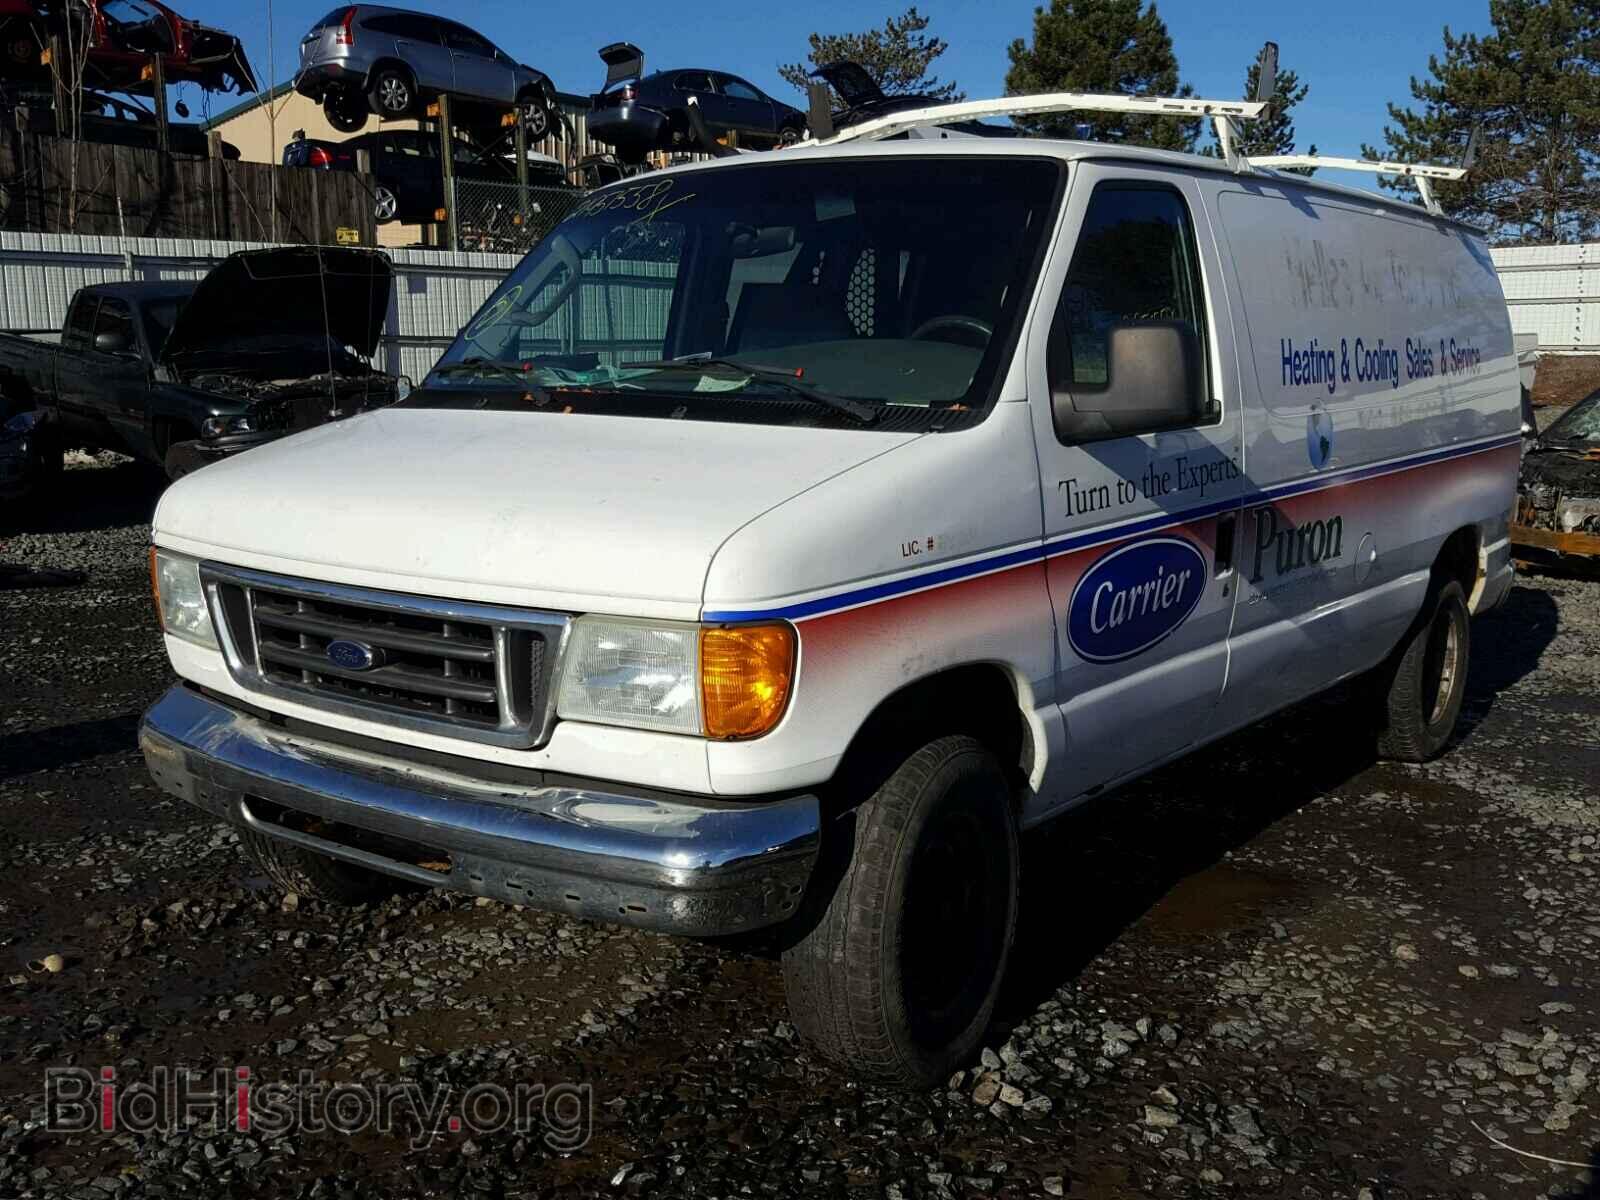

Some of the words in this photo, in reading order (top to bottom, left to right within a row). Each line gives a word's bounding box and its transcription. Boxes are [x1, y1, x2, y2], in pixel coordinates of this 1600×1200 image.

[1281, 337, 1336, 394] Heating
[1340, 338, 1351, 383] &
[1355, 336, 1399, 389] Cooling
[1405, 336, 1434, 379] Sales
[1440, 337, 1448, 375] &
[1449, 336, 1481, 374] Service
[1058, 478, 1111, 518] Turn
[1116, 478, 1136, 505] to
[1142, 462, 1171, 499] the
[1175, 456, 1240, 497] Experts
[901, 540, 923, 557] LIC.
[927, 536, 934, 552] #
[1248, 505, 1344, 585] Puron
[1089, 564, 1191, 634] Carrier
